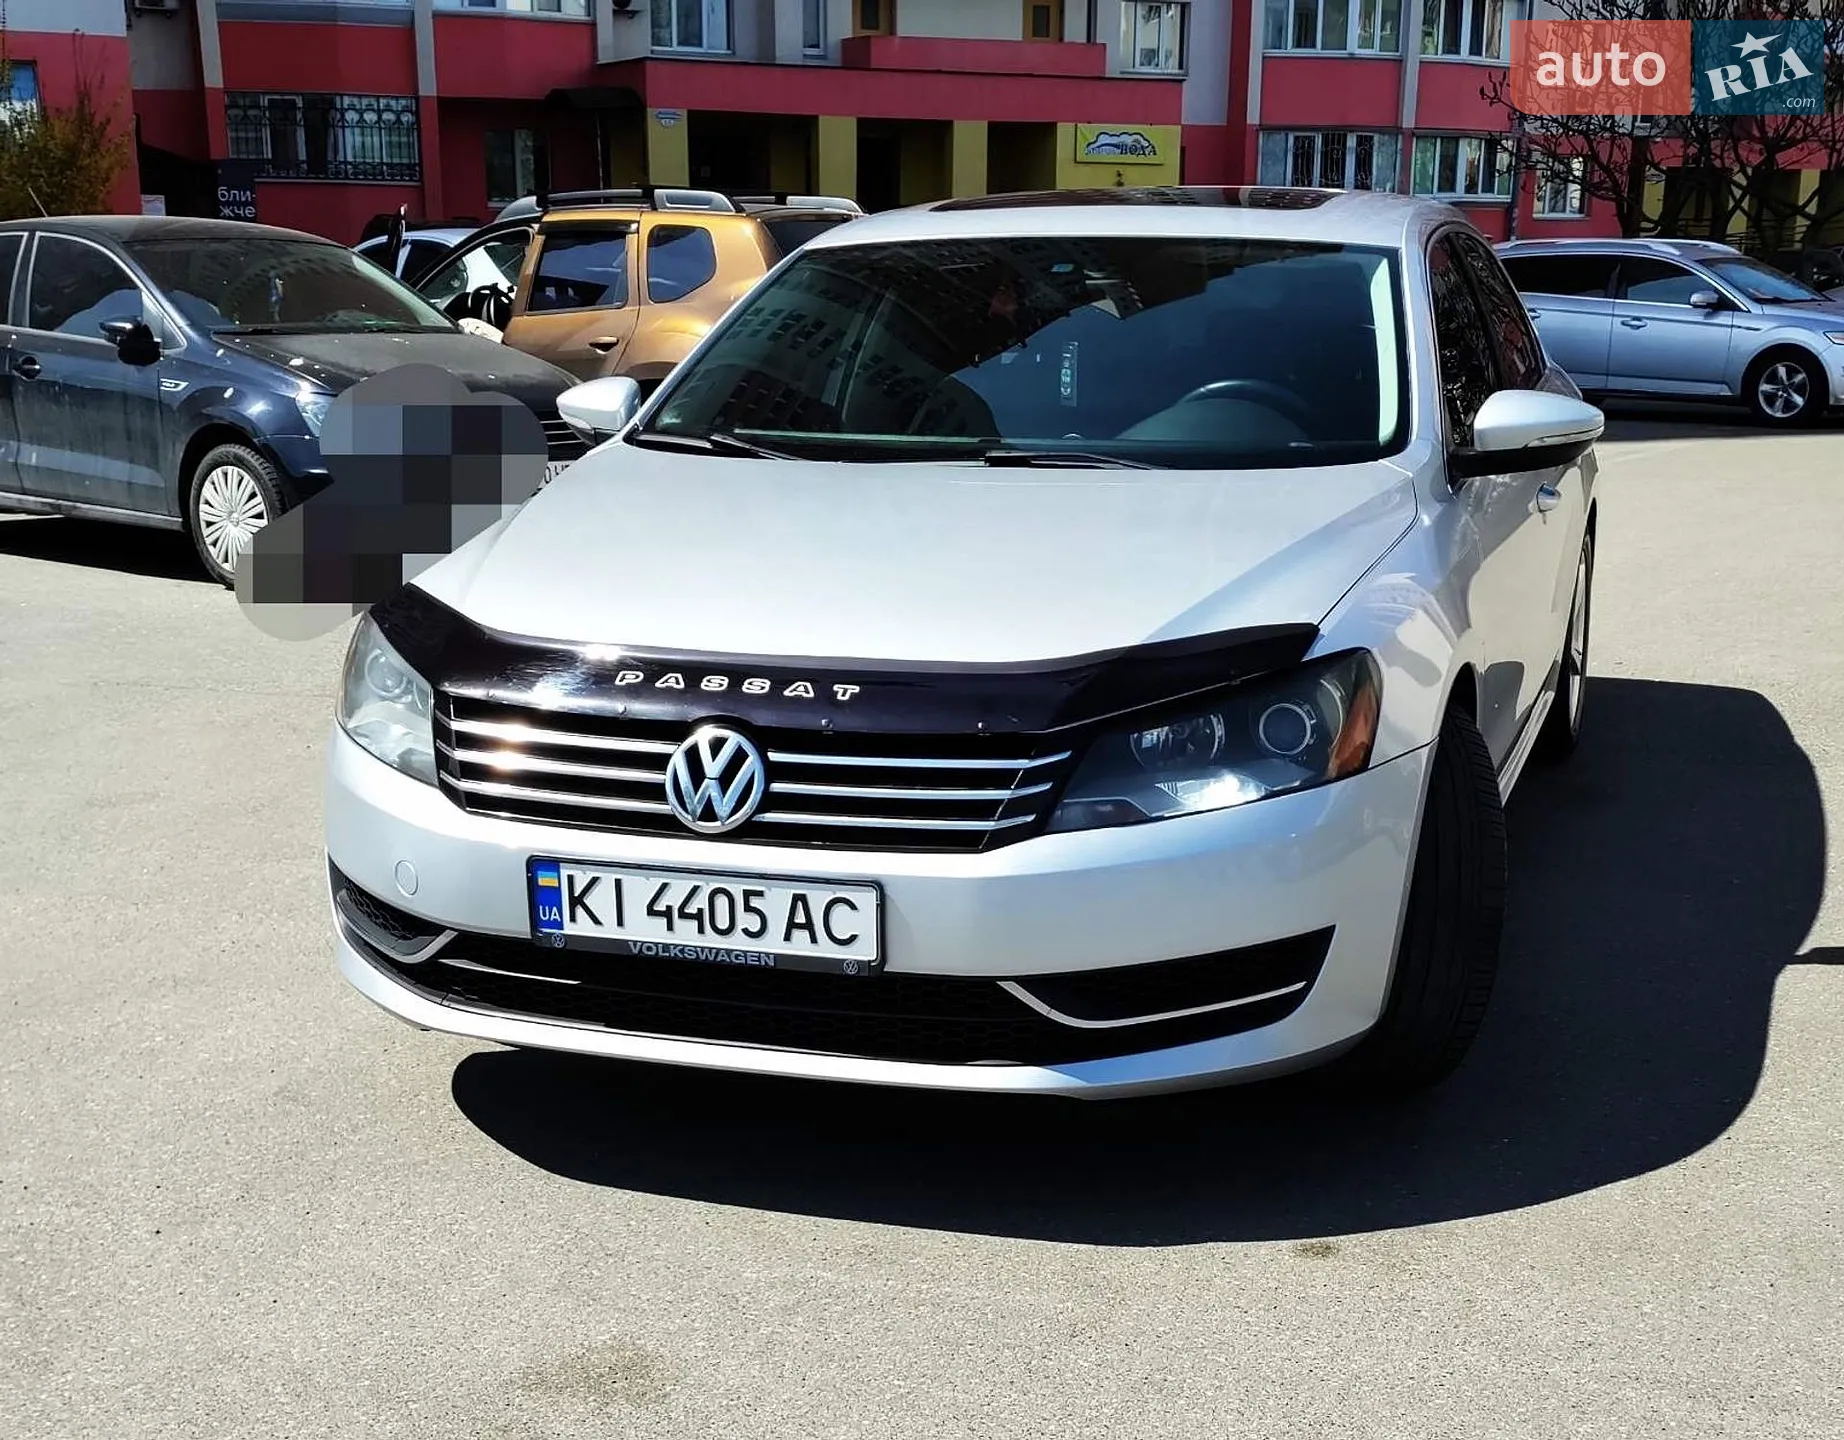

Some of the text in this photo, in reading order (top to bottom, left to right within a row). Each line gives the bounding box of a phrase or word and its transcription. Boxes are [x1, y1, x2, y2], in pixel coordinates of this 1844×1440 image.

[219, 205, 256, 217] жче
[615, 670, 860, 701] PASSAT
[539, 905, 561, 922] UA
[566, 873, 859, 946] KI 4405 AC
[627, 940, 775, 967] VOLKSWAGEN
